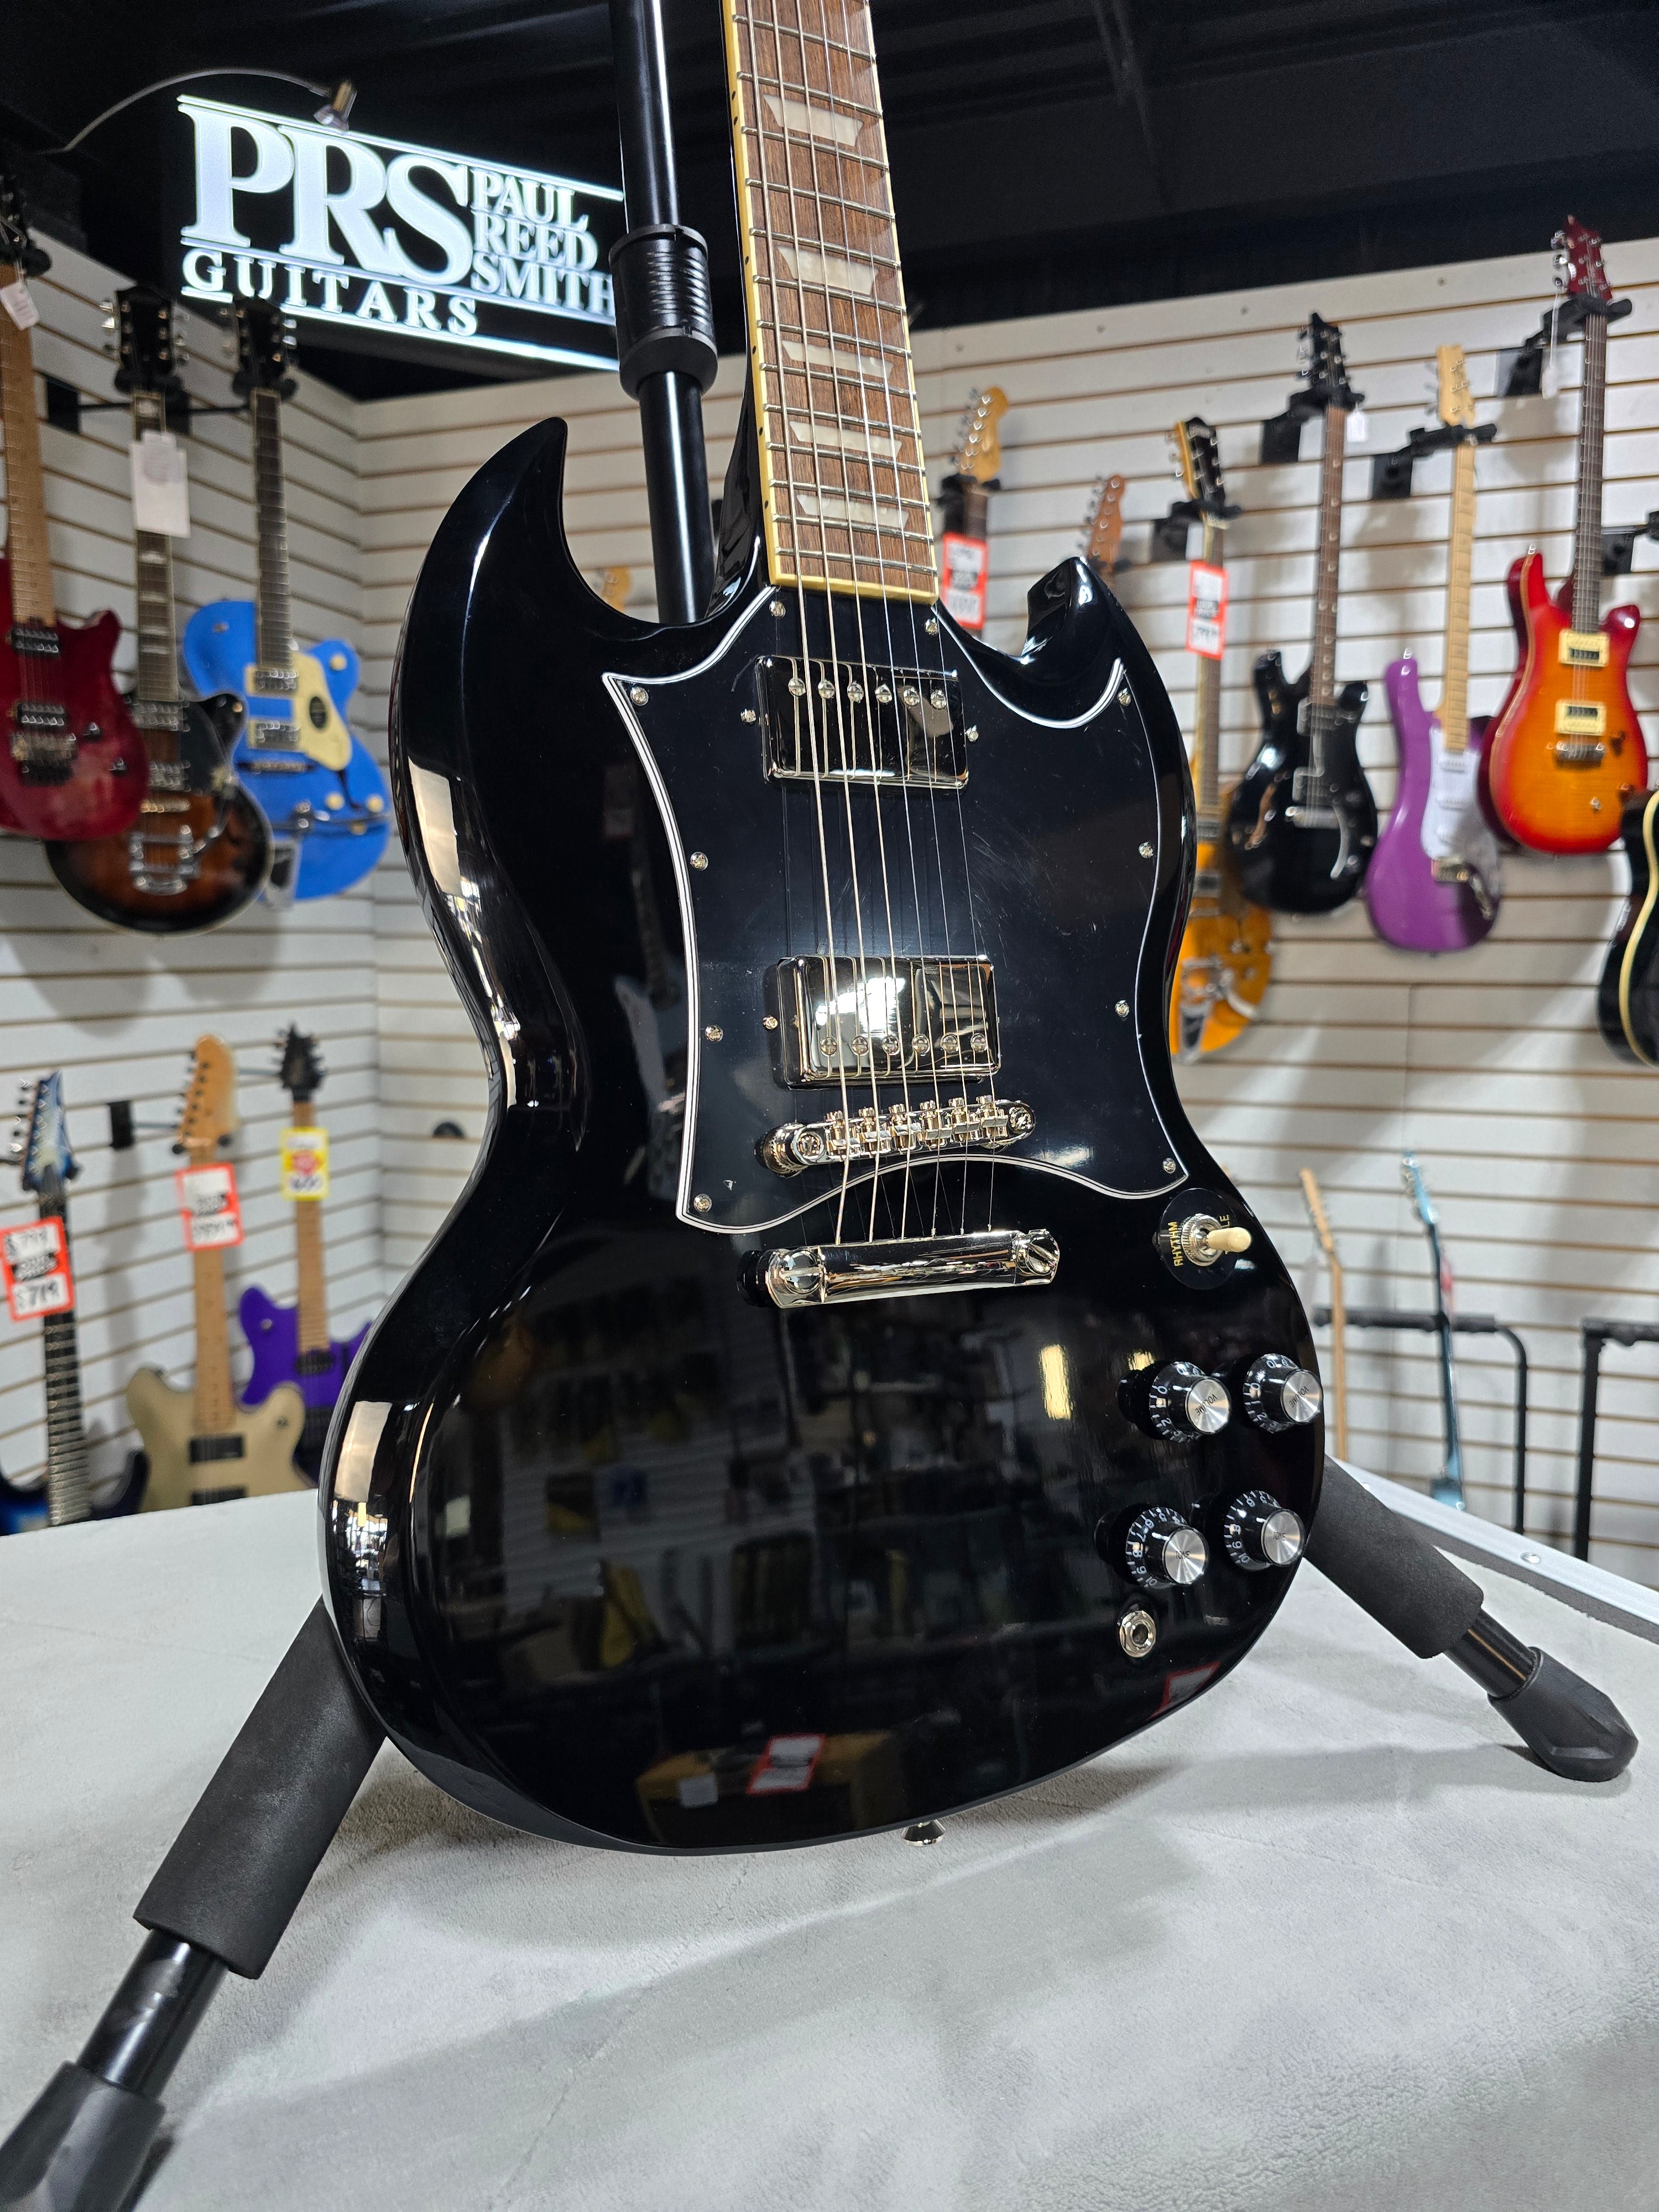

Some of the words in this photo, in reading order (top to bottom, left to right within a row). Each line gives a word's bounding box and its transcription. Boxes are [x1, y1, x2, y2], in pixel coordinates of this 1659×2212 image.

[178, 103, 473, 285] PRS
[470, 167, 588, 232] PAUL
[471, 210, 598, 272] REED
[471, 252, 615, 317] SMITH
[182, 248, 478, 337] GUITARS
[1167, 1221, 1184, 1267] RHYTHM
[1157, 1386, 1168, 1395] 0
[1288, 1386, 1310, 1408] VOLUME
[1194, 1394, 1218, 1416] VOLUME
[1256, 1412, 1267, 1421] 2
[1161, 1418, 1172, 1427] 2
[1272, 1531, 1286, 1541] TONE
[1132, 1550, 1143, 1558] 8
[1175, 1550, 1190, 1559] TONE
[1238, 1552, 1250, 1563] 10
[1136, 1566, 1147, 1574] 9
[1145, 1576, 1158, 1586] 10
